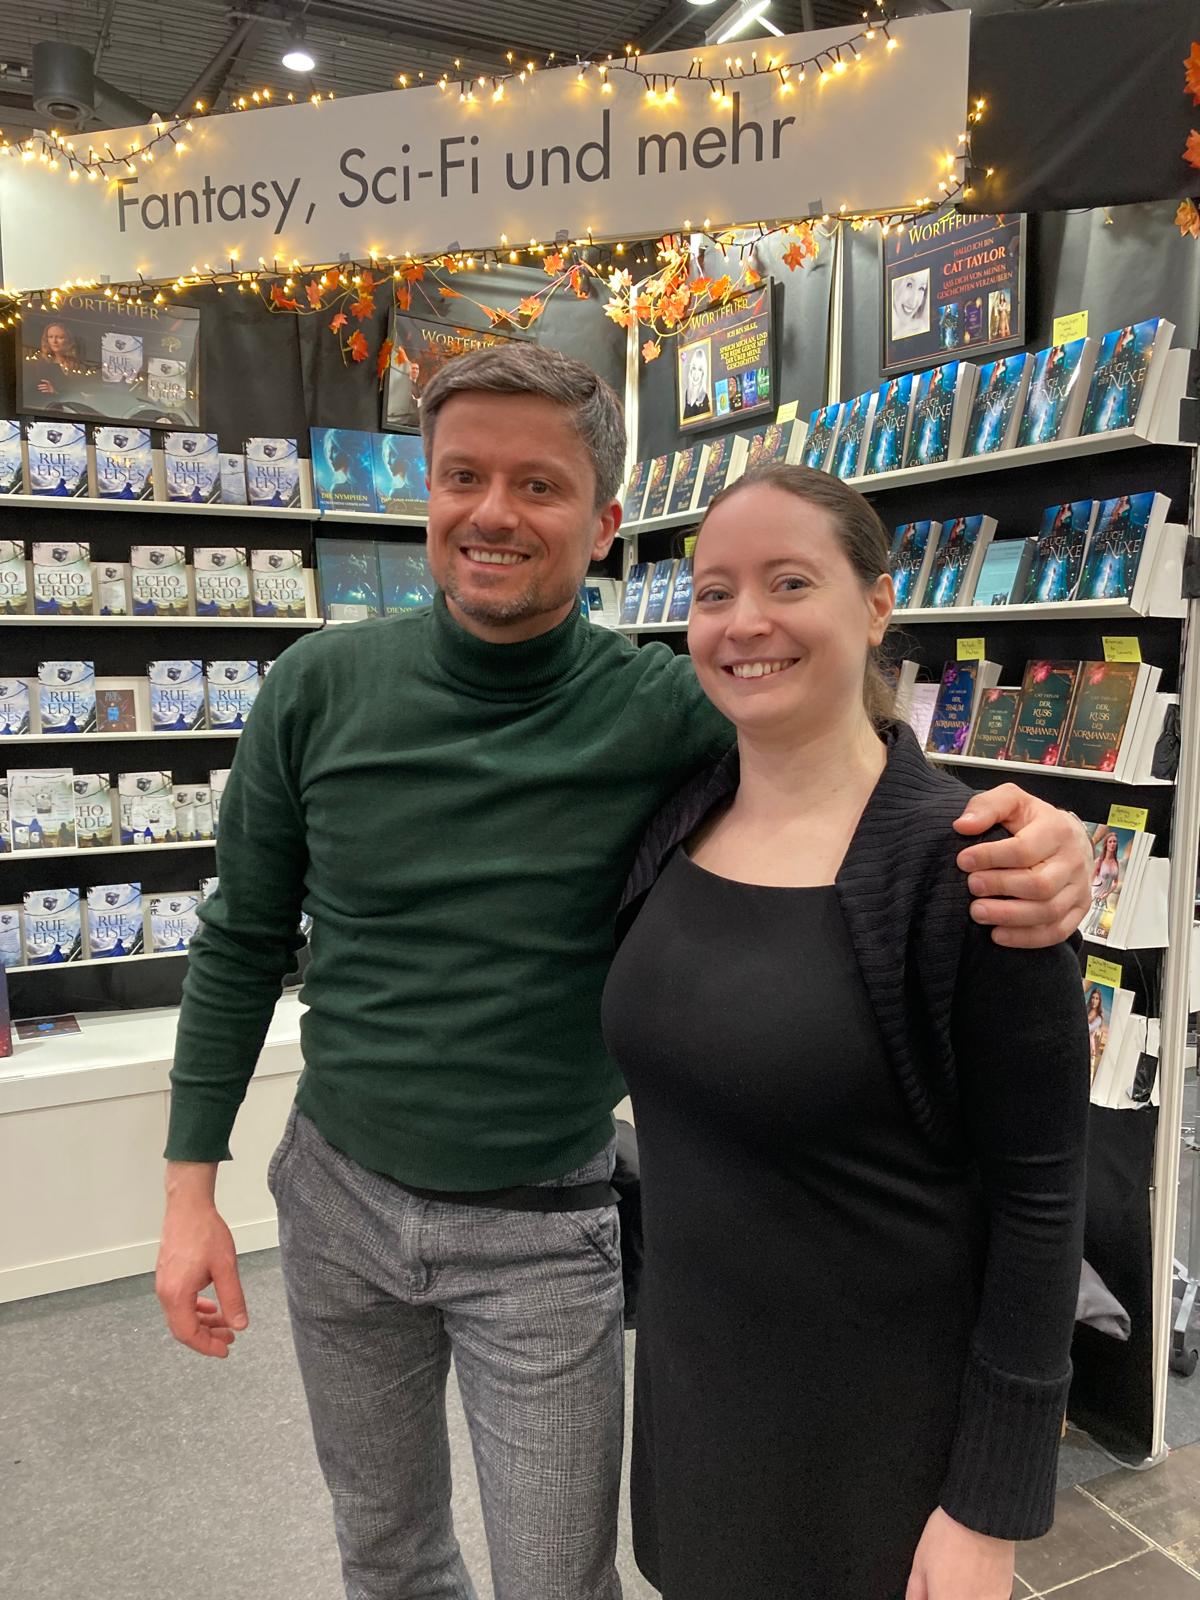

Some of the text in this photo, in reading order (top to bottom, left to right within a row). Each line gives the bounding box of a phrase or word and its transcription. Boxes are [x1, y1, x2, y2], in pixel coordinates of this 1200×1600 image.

[118, 91, 796, 234] Fantasy, Sci-Fi und mehr
[943, 246, 1006, 276] CAT TAYLOR
[1100, 363, 1128, 376] FLUCH
[1109, 367, 1146, 390] NIXE
[919, 397, 939, 408] FLUCH
[926, 403, 952, 423] NIXE
[883, 415, 906, 433] NIXE
[40, 453, 70, 465] RUF
[37, 464, 80, 480] EISES
[176, 461, 205, 473] RUF
[256, 466, 286, 477] RUF
[104, 468, 145, 483] EISES
[174, 472, 213, 487] EISES
[255, 477, 294, 490] EISES
[334, 492, 369, 502] NYMPHEN
[1040, 535, 1067, 547] FLUCH
[1049, 544, 1083, 563] NIXE
[1105, 539, 1142, 559] NIXE
[945, 554, 970, 571] NIXE
[38, 573, 84, 585] ECHO
[136, 575, 180, 587] ECHO
[200, 577, 241, 588] ECHO
[256, 578, 297, 590] ECHO
[41, 585, 86, 597] ERDE
[139, 586, 181, 598] ERDE
[202, 588, 242, 600] ERDE
[259, 589, 299, 600] ERDE
[50, 691, 80, 702] RUF
[160, 689, 189, 701] RUF
[218, 689, 246, 701] RUF
[48, 702, 89, 717] EISES
[158, 701, 198, 714] EISES
[1039, 700, 1052, 709] DER
[1096, 703, 1110, 712] DER
[1032, 708, 1053, 718] KUSS
[1089, 711, 1110, 721] KUSS
[1017, 725, 1058, 737] NORMANNEN
[1073, 729, 1118, 742] NORMANNEN
[35, 919, 66, 932] RUF
[98, 914, 128, 927] RUF
[164, 919, 186, 929] RUF
[33, 930, 74, 945] EISES
[96, 925, 137, 939] EISES
